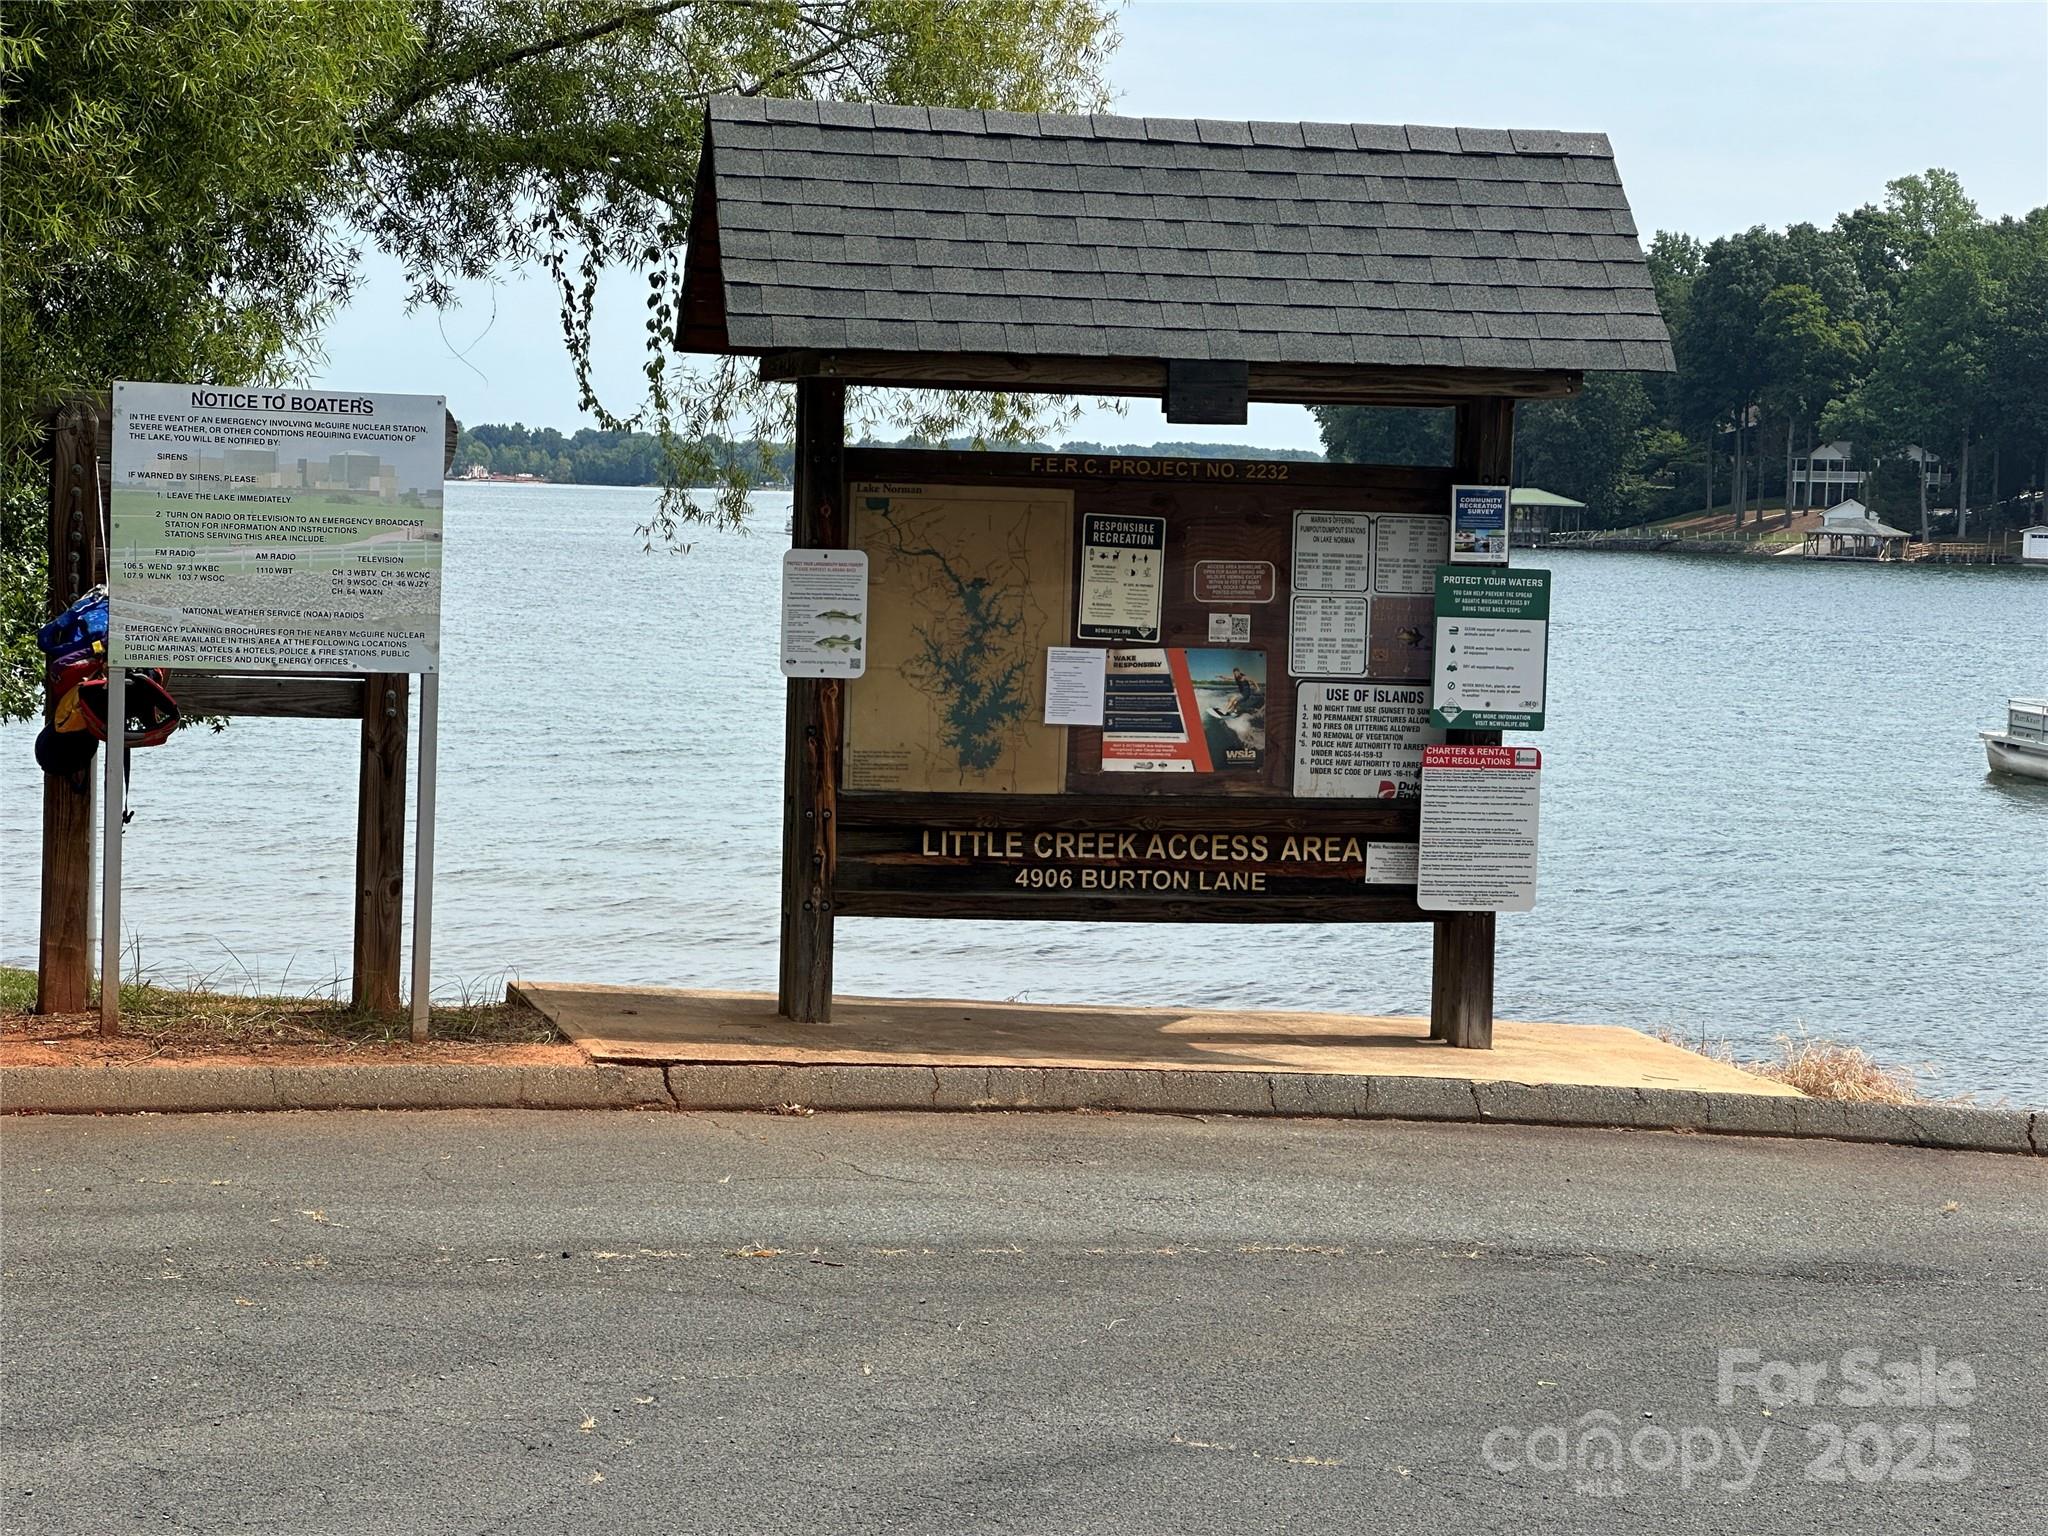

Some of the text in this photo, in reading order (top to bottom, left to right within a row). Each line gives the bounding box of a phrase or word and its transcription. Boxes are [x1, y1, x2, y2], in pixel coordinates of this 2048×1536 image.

[192, 392, 373, 414] NOTICE TO BOATERS
[215, 417, 267, 426] EMERGENCY
[270, 419, 312, 428] INVOLVING
[130, 423, 163, 431] SEVERE
[224, 427, 251, 435] OTHER
[254, 428, 304, 437] CONDITIONS
[306, 431, 351, 439] REQUIRING
[354, 433, 403, 442] EVACUATION
[148, 434, 173, 442] LAKE,
[228, 437, 265, 445] NOTIFIED
[268, 438, 281, 446] BY:
[157, 453, 188, 461] SIRENS
[1030, 458, 1288, 480] F.E.R.C. PROJECT NO. 2232
[138, 472, 174, 480] WARNED
[856, 483, 922, 494] Lake Norman
[165, 521, 200, 529] STATION
[221, 523, 276, 531] INFORMATION
[1094, 521, 1155, 534] RESPONSIBLE
[165, 531, 204, 539] STATIONS
[207, 532, 243, 540] SERVING
[290, 535, 327, 543] INCLUDE:
[1093, 532, 1154, 545] RECREATION
[358, 556, 404, 564] TELEVISION
[1444, 576, 1543, 587] PROTECT YOUR WATERS
[225, 609, 264, 617] WEATHER
[304, 611, 332, 619] (NOAA)
[125, 625, 178, 633] EMERGENCY
[181, 626, 222, 634] PLANNING
[225, 628, 276, 636] BROCHURES
[350, 631, 385, 639] McGUIRE
[182, 636, 226, 644] AVAILABLE
[312, 639, 360, 647] FOLLOWING
[1326, 688, 1424, 704] USE OF ISLANDS
[1324, 723, 1342, 731] FIRES
[1355, 724, 1388, 732] LITTERING
[1390, 725, 1421, 733] ALLOWED
[1324, 732, 1353, 740] REMOVAL
[1366, 733, 1403, 741] VEGETATION
[1355, 742, 1391, 750] AUTHORITY
[1226, 748, 1257, 759] wsia
[1426, 747, 1510, 757] CHARTER & RENTAL
[1426, 756, 1511, 766] BOAT REGULATIONS
[1345, 768, 1361, 776] CODE
[923, 830, 1022, 858] LITTLE
[1034, 833, 1137, 859] CREEK
[1145, 834, 1269, 863] ACCESS
[1281, 837, 1362, 863] AREA
[1015, 868, 1266, 892] 4906 BURTON LANE
